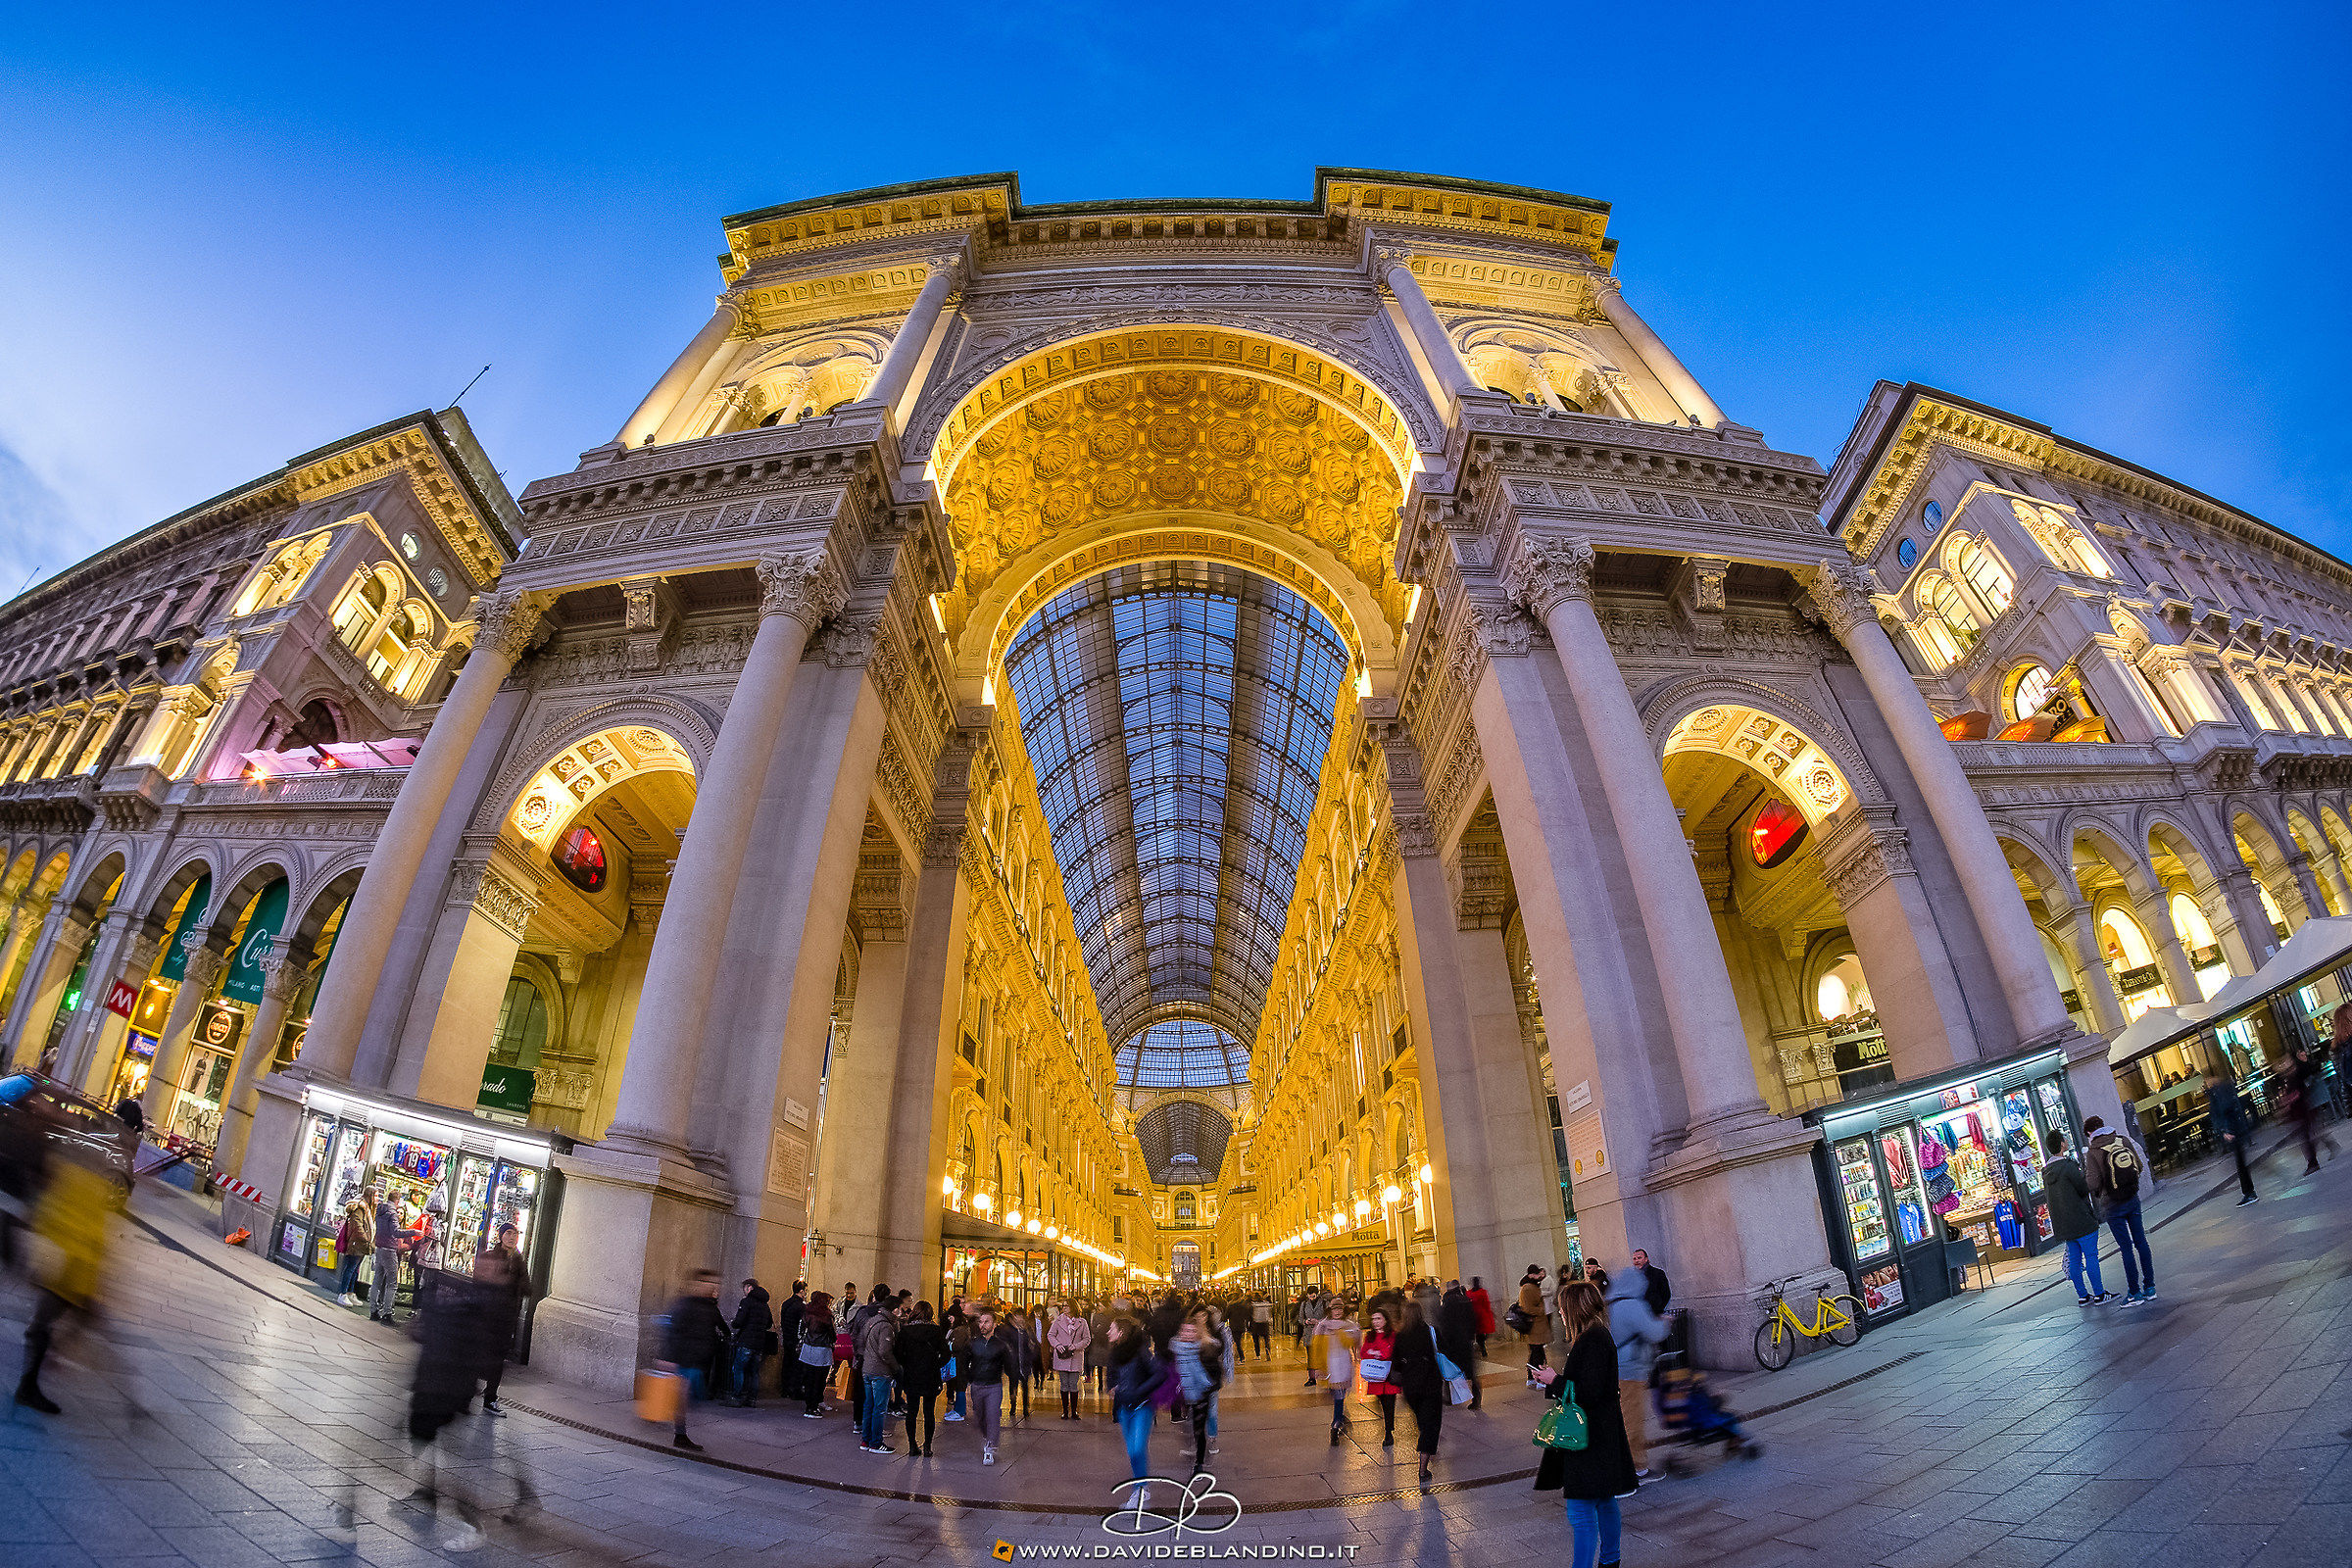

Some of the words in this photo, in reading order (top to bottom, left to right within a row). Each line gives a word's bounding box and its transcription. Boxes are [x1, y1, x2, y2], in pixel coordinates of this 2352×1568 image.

[110, 988, 132, 1012] M
[1857, 1038, 1889, 1059] Mott
[408, 1152, 418, 1168] 19
[1351, 1230, 1380, 1242] Motta
